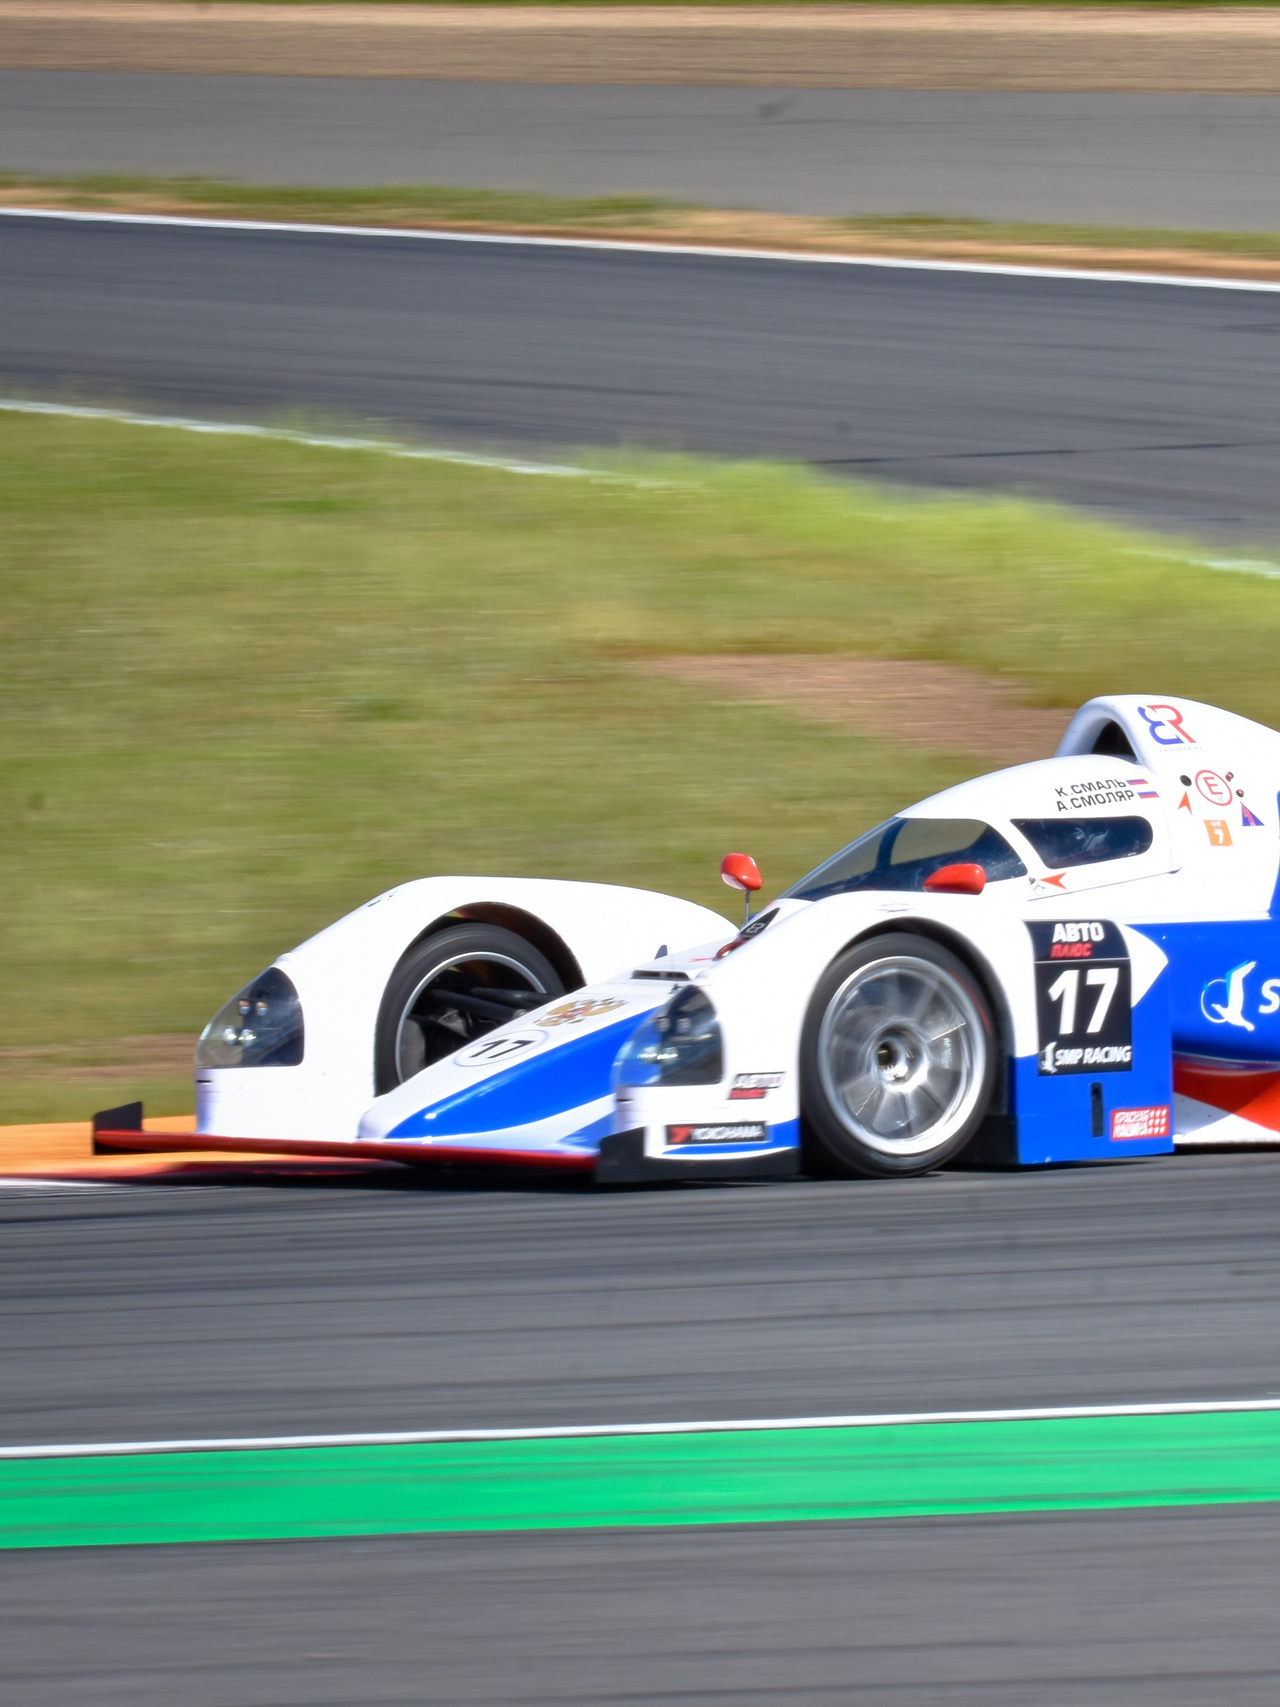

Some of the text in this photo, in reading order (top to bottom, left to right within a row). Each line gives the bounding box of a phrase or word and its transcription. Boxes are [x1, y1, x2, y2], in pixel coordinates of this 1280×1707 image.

[1047, 967, 1119, 1035] 17
[468, 1039, 536, 1059] 17
[1055, 1045, 1132, 1066] SMP RACING
